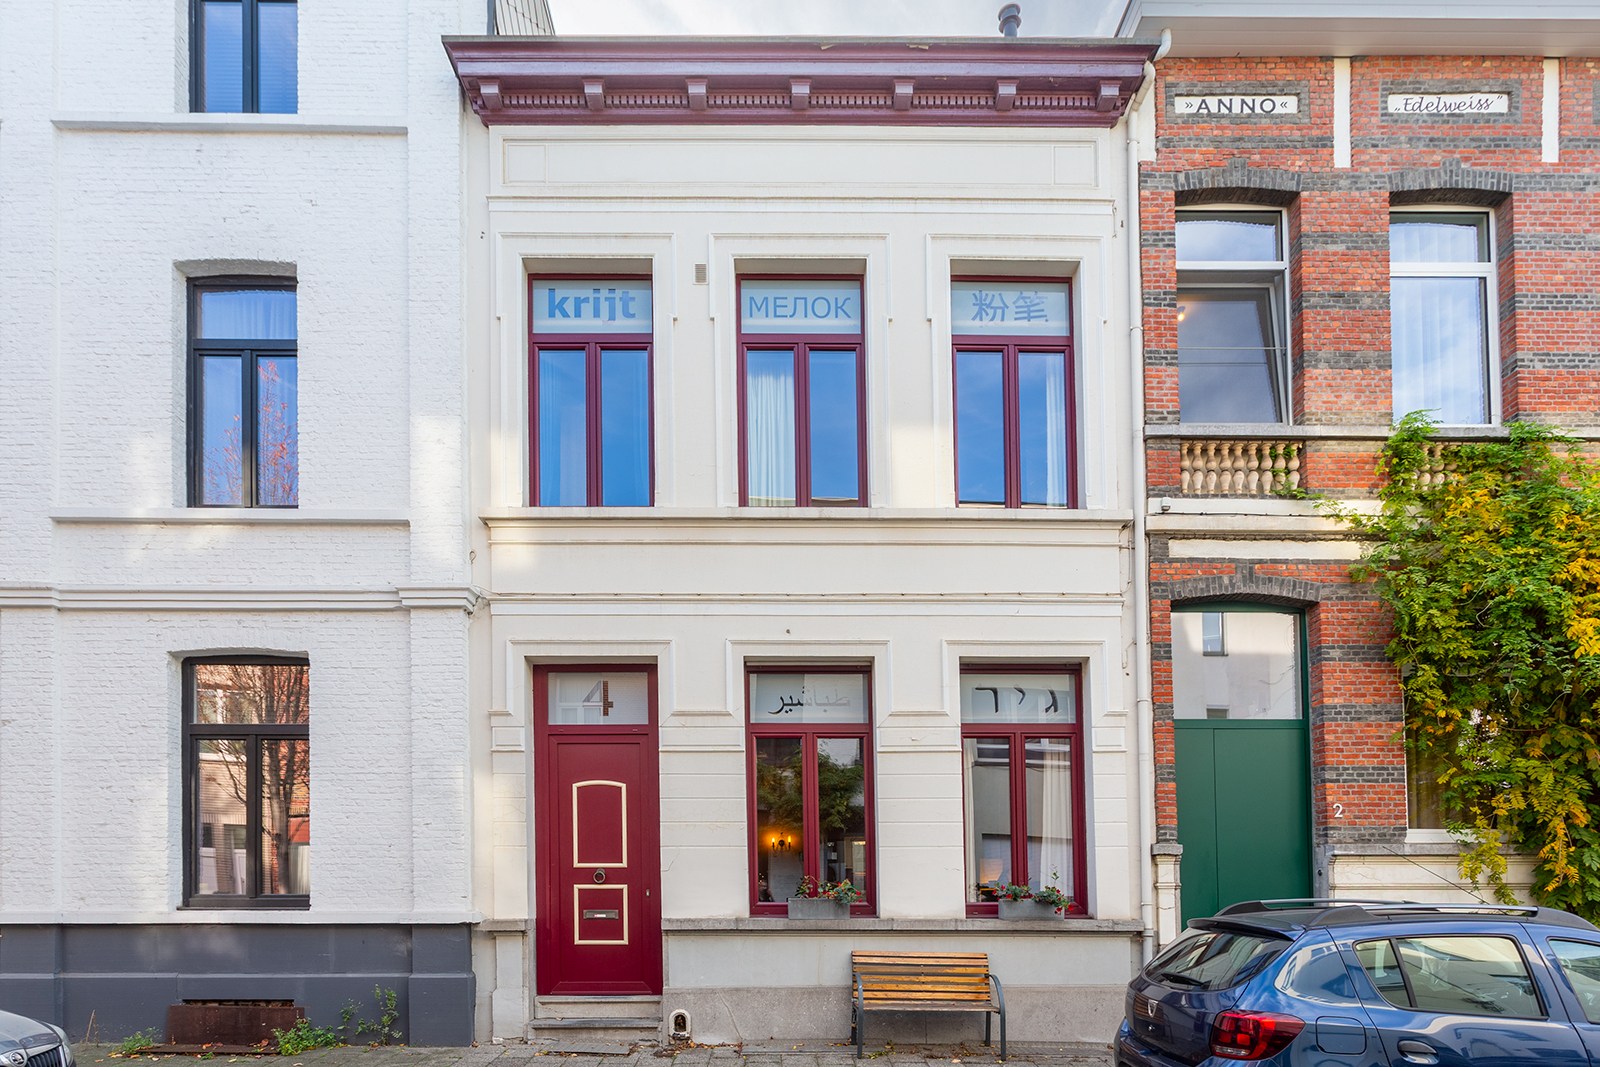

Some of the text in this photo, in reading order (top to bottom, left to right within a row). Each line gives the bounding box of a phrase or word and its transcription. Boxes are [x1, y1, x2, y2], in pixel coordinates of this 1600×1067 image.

[548, 288, 636, 323] krijt
[749, 296, 852, 319] МЕЛОК
[582, 680, 614, 717] 4
[768, 684, 850, 715] طباشير
[975, 687, 1059, 713] גיר
[1333, 803, 1344, 818] 2
